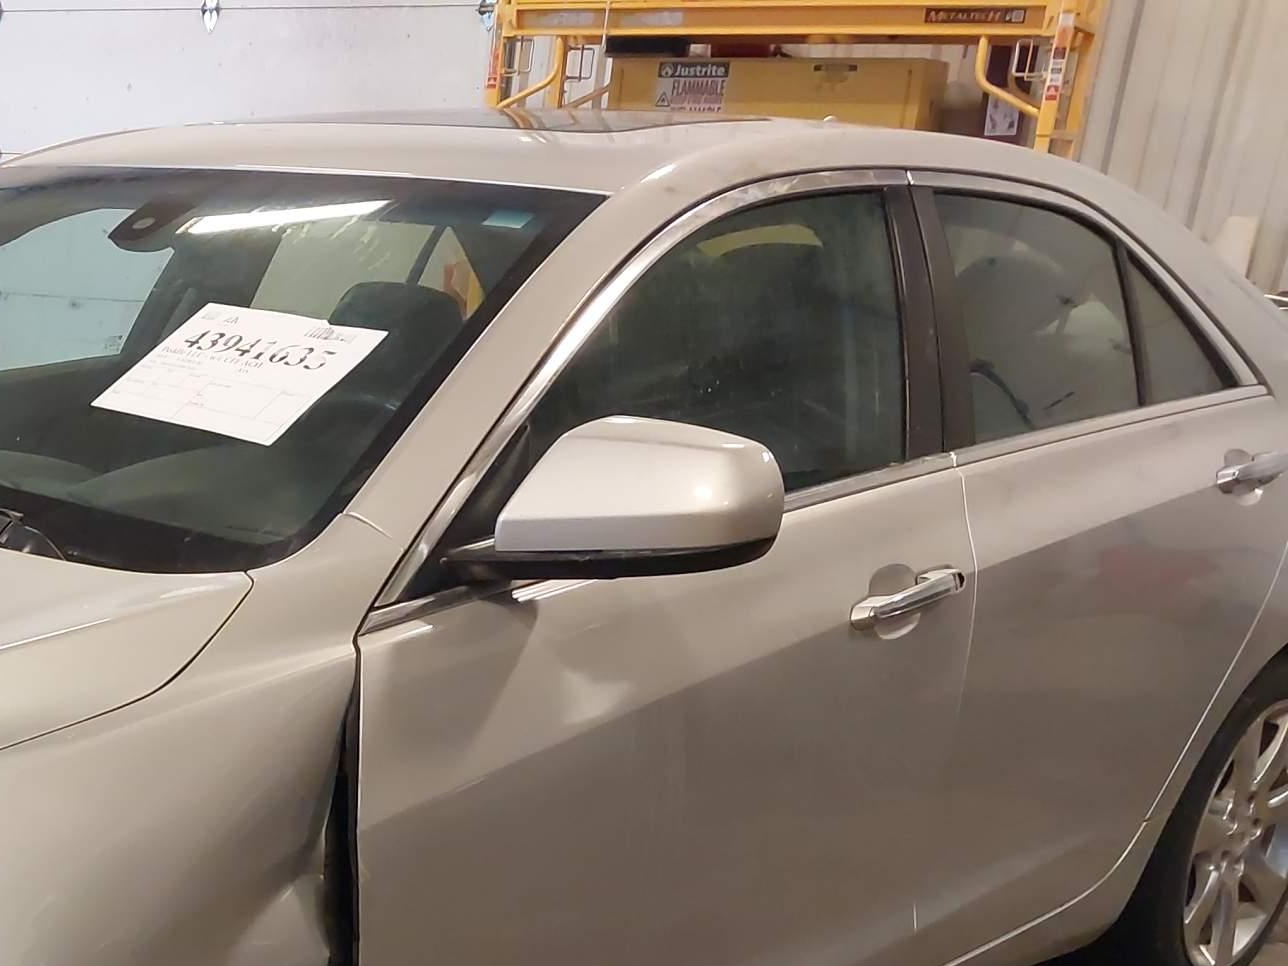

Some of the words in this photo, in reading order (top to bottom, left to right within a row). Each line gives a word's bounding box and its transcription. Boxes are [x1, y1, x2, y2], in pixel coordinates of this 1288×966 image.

[674, 63, 726, 77] Justrite
[671, 79, 726, 97] FLAMMABLE
[183, 329, 337, 371] 43941635
